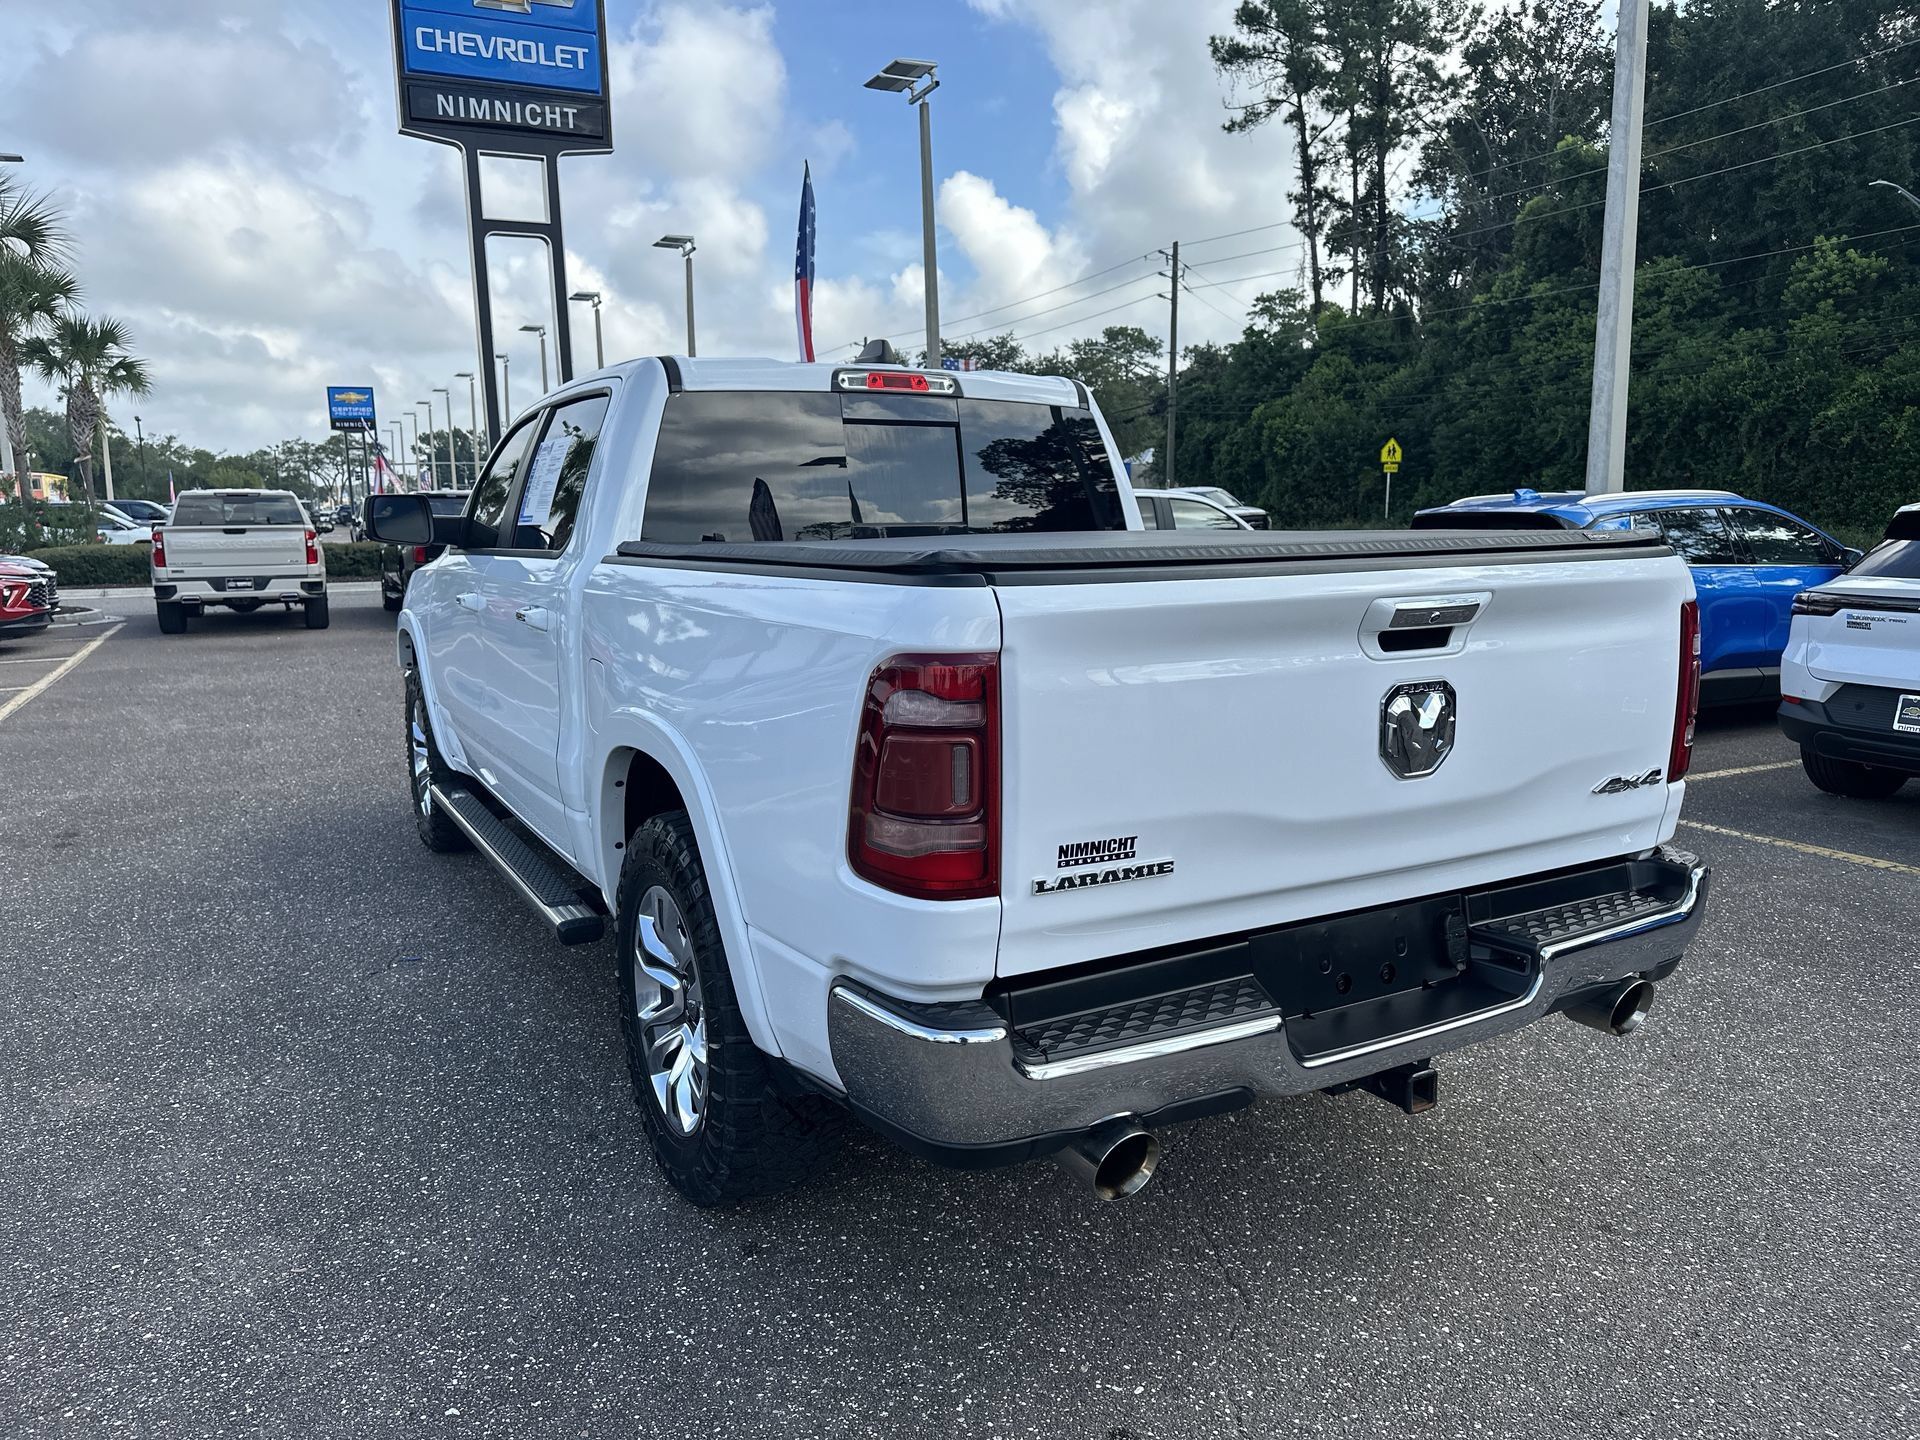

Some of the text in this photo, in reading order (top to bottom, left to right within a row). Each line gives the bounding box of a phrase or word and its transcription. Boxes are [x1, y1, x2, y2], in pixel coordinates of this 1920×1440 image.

[415, 26, 589, 70] CHEVROLET
[436, 93, 578, 129] NIMNICHT
[1400, 682, 1444, 694] RAM
[1058, 836, 1138, 860] NIMNICHT
[1059, 852, 1135, 867] CHEVROLET
[1033, 858, 1174, 895] LARAMIE
